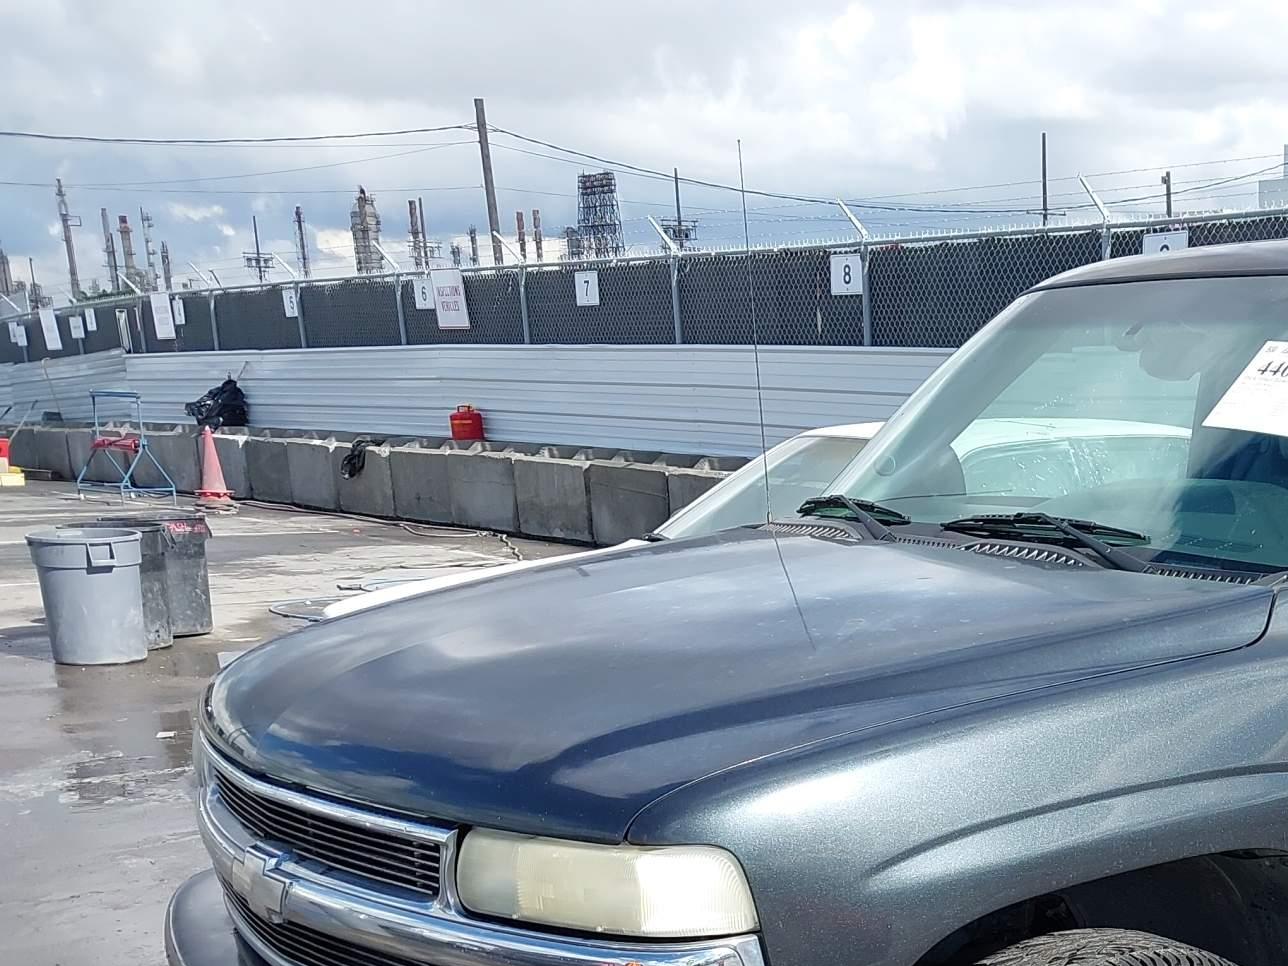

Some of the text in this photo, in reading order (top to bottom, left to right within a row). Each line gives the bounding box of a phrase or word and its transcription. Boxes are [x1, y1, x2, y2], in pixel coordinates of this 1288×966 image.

[843, 264, 852, 285] 8
[421, 286, 428, 302] 6
[583, 279, 590, 297] 7
